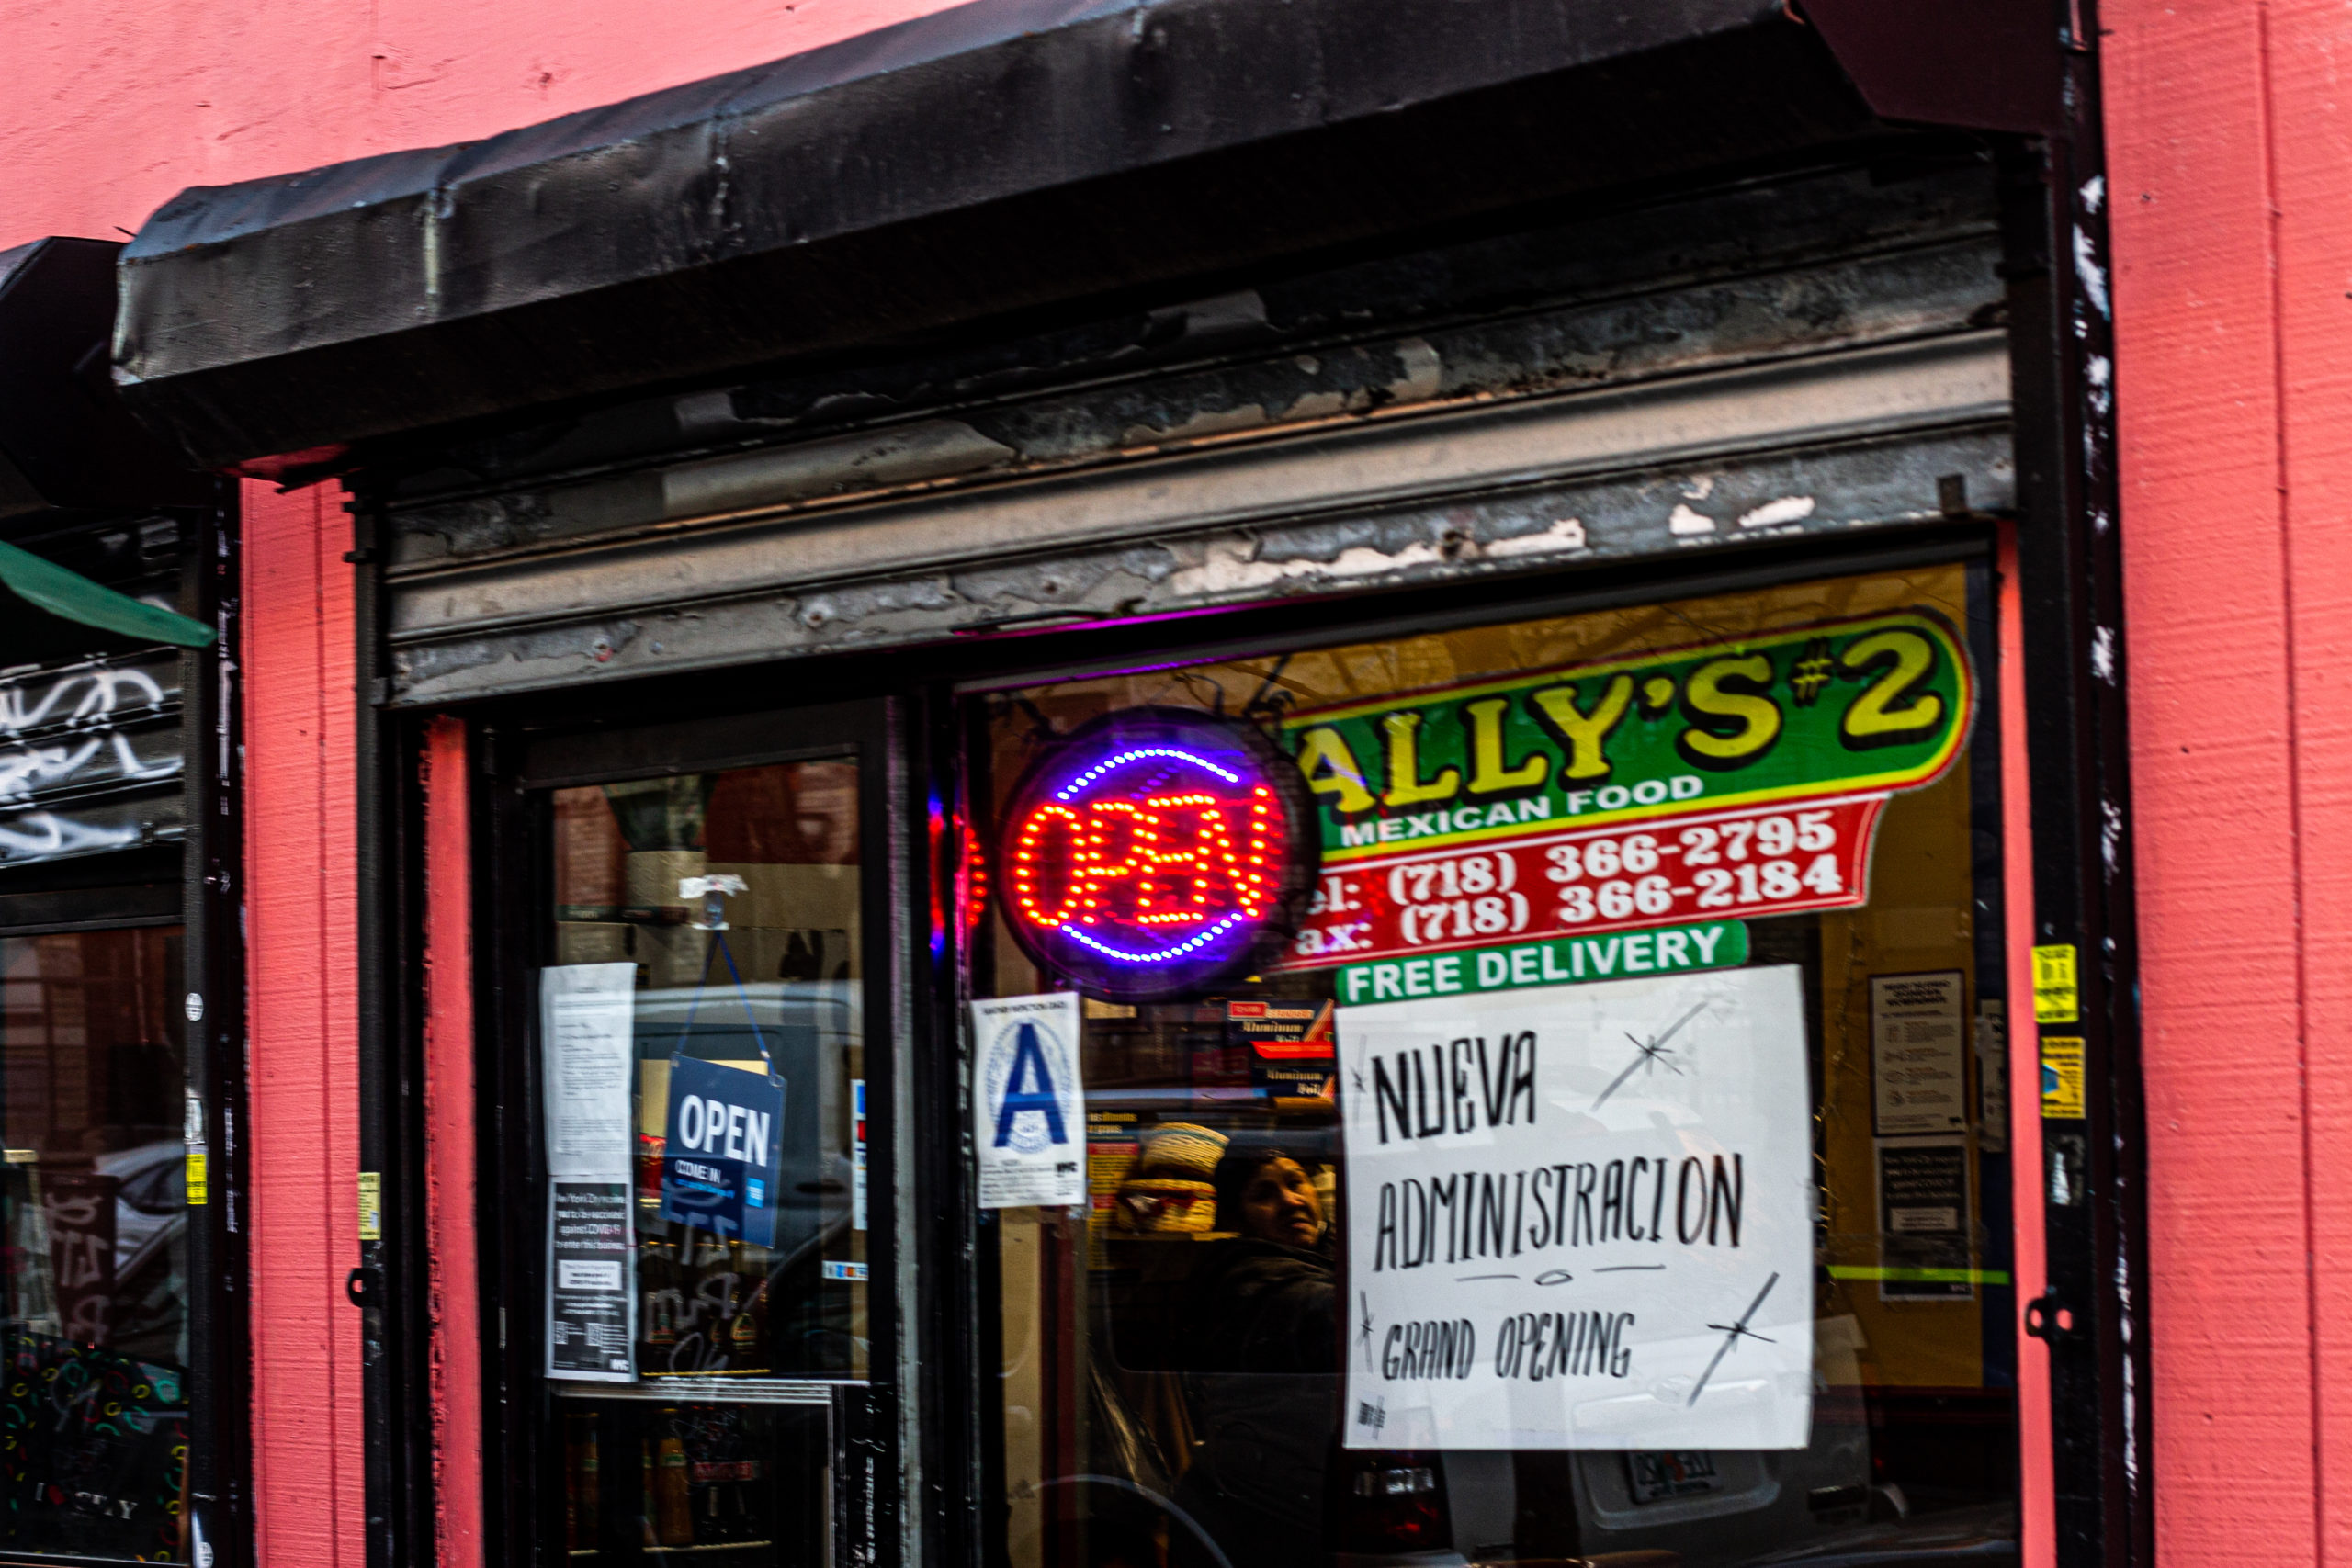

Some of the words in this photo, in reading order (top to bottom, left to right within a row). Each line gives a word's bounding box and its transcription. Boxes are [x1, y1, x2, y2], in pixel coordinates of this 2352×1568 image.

[1296, 652, 1782, 816] ALLY'S
[1015, 783, 1268, 928] OPEN
[1306, 876, 1360, 915] el:
[1388, 852, 1517, 906] (718)
[1545, 810, 1838, 883] 366-2795
[1340, 795, 1551, 847] MEXICAN
[1567, 774, 1703, 815] FOOD
[1295, 922, 1374, 956] ax:
[1401, 891, 1529, 945] (718)
[1559, 853, 1844, 923] 366-2184
[1346, 955, 1463, 1002] FREE
[1477, 926, 1725, 988] DELIVERY
[678, 1094, 771, 1168] OPEN
[991, 1022, 1069, 1148] A
[1371, 1029, 1538, 1145] NUEVA
[674, 1159, 708, 1181] COME
[709, 1167, 722, 1184] IN
[1373, 1152, 1744, 1273] ADMINISTRACION
[1382, 1318, 1476, 1382] GRAND
[1495, 1310, 1635, 1382] OPENING
